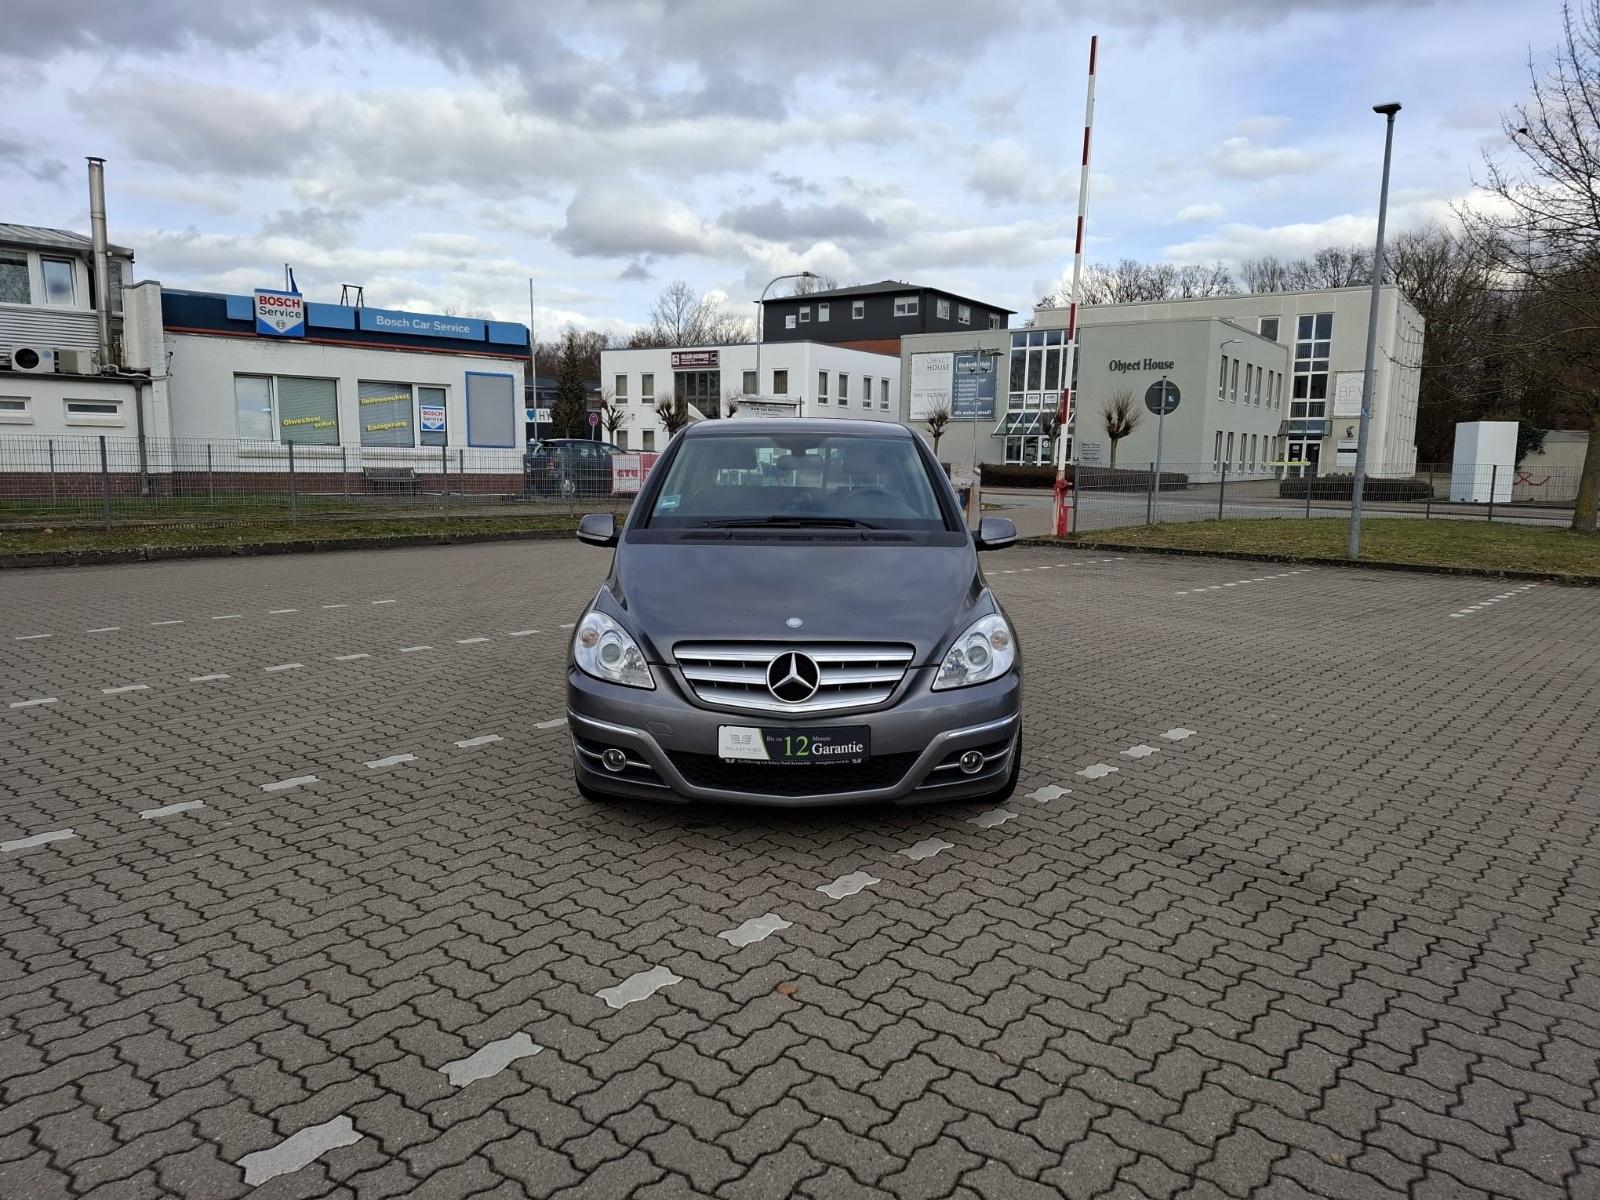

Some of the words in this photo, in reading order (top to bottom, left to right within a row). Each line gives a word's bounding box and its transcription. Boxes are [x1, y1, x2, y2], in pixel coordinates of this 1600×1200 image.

[259, 295, 300, 308] BOSCH
[259, 306, 302, 318] Service
[376, 315, 410, 328] Bosch
[412, 319, 431, 329] Car
[433, 321, 470, 333] Service
[1109, 359, 1141, 374] Object
[1143, 358, 1175, 371] House
[784, 736, 809, 756] 12
[812, 741, 863, 755] Garantie
